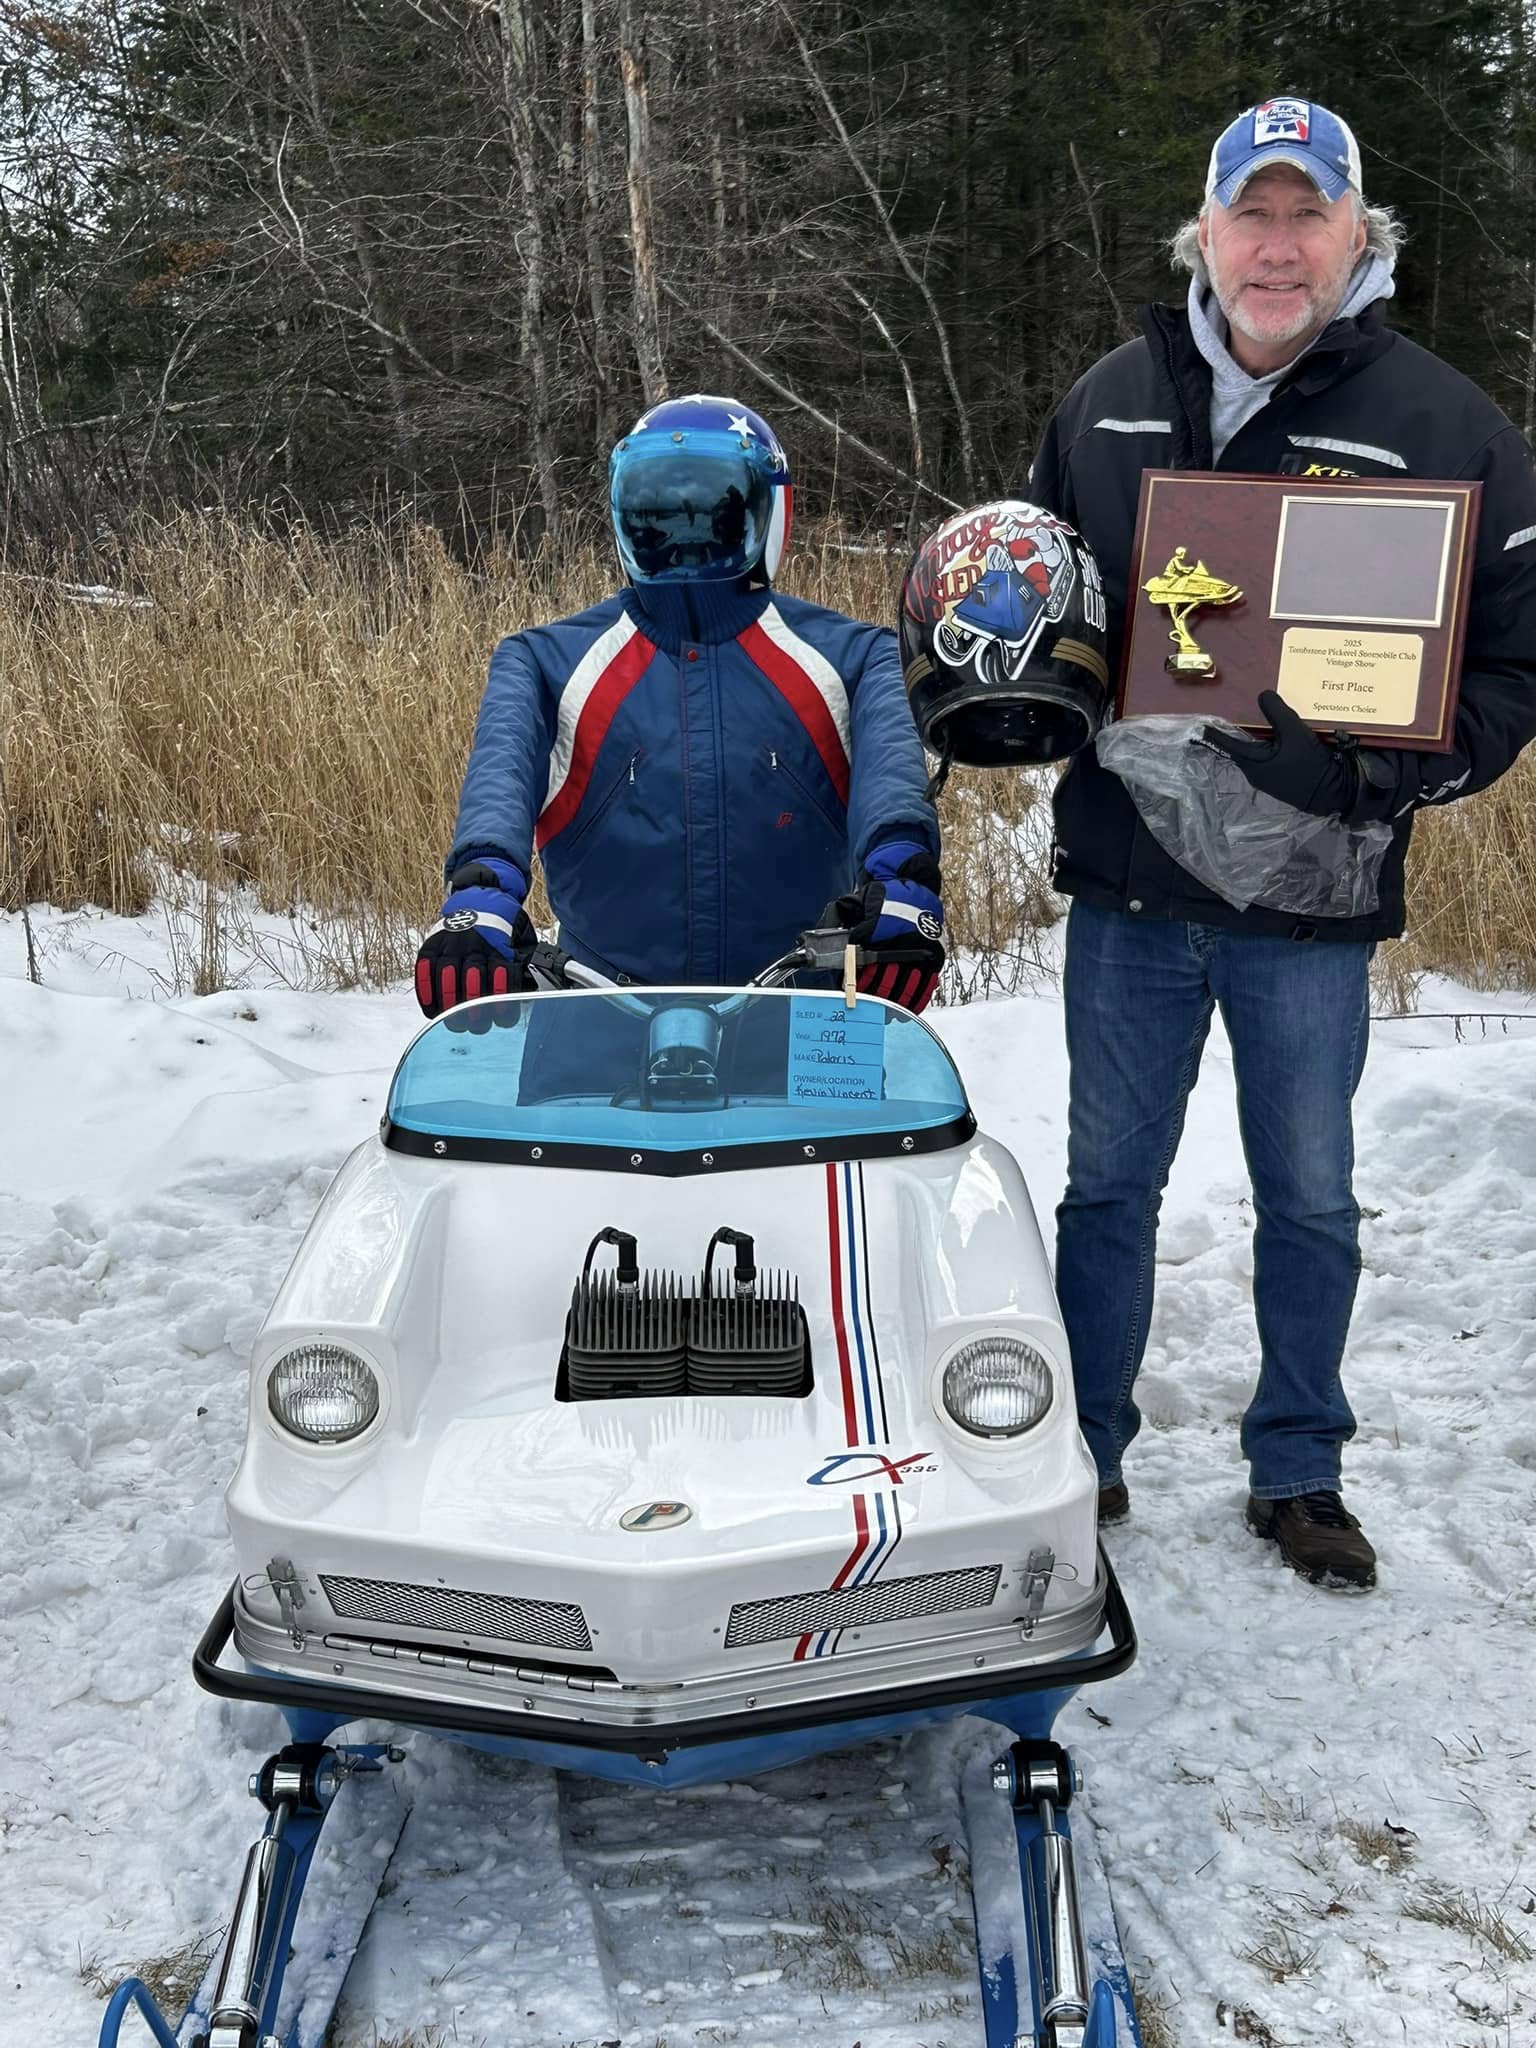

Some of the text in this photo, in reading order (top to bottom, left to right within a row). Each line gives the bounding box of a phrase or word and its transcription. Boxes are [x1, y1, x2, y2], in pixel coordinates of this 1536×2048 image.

[1343, 639, 1363, 648] 2025
[1398, 652, 1417, 661] Club
[1326, 658, 1377, 668] Vintage Show
[1321, 680, 1375, 693] First Place
[1313, 702, 1377, 713] Spectators Choice
[795, 1010, 816, 1019] SLED
[820, 1030, 846, 1045] 1972
[794, 1048, 856, 1065] MAKE Polaris
[794, 1083, 877, 1099] Kevin Vincent
